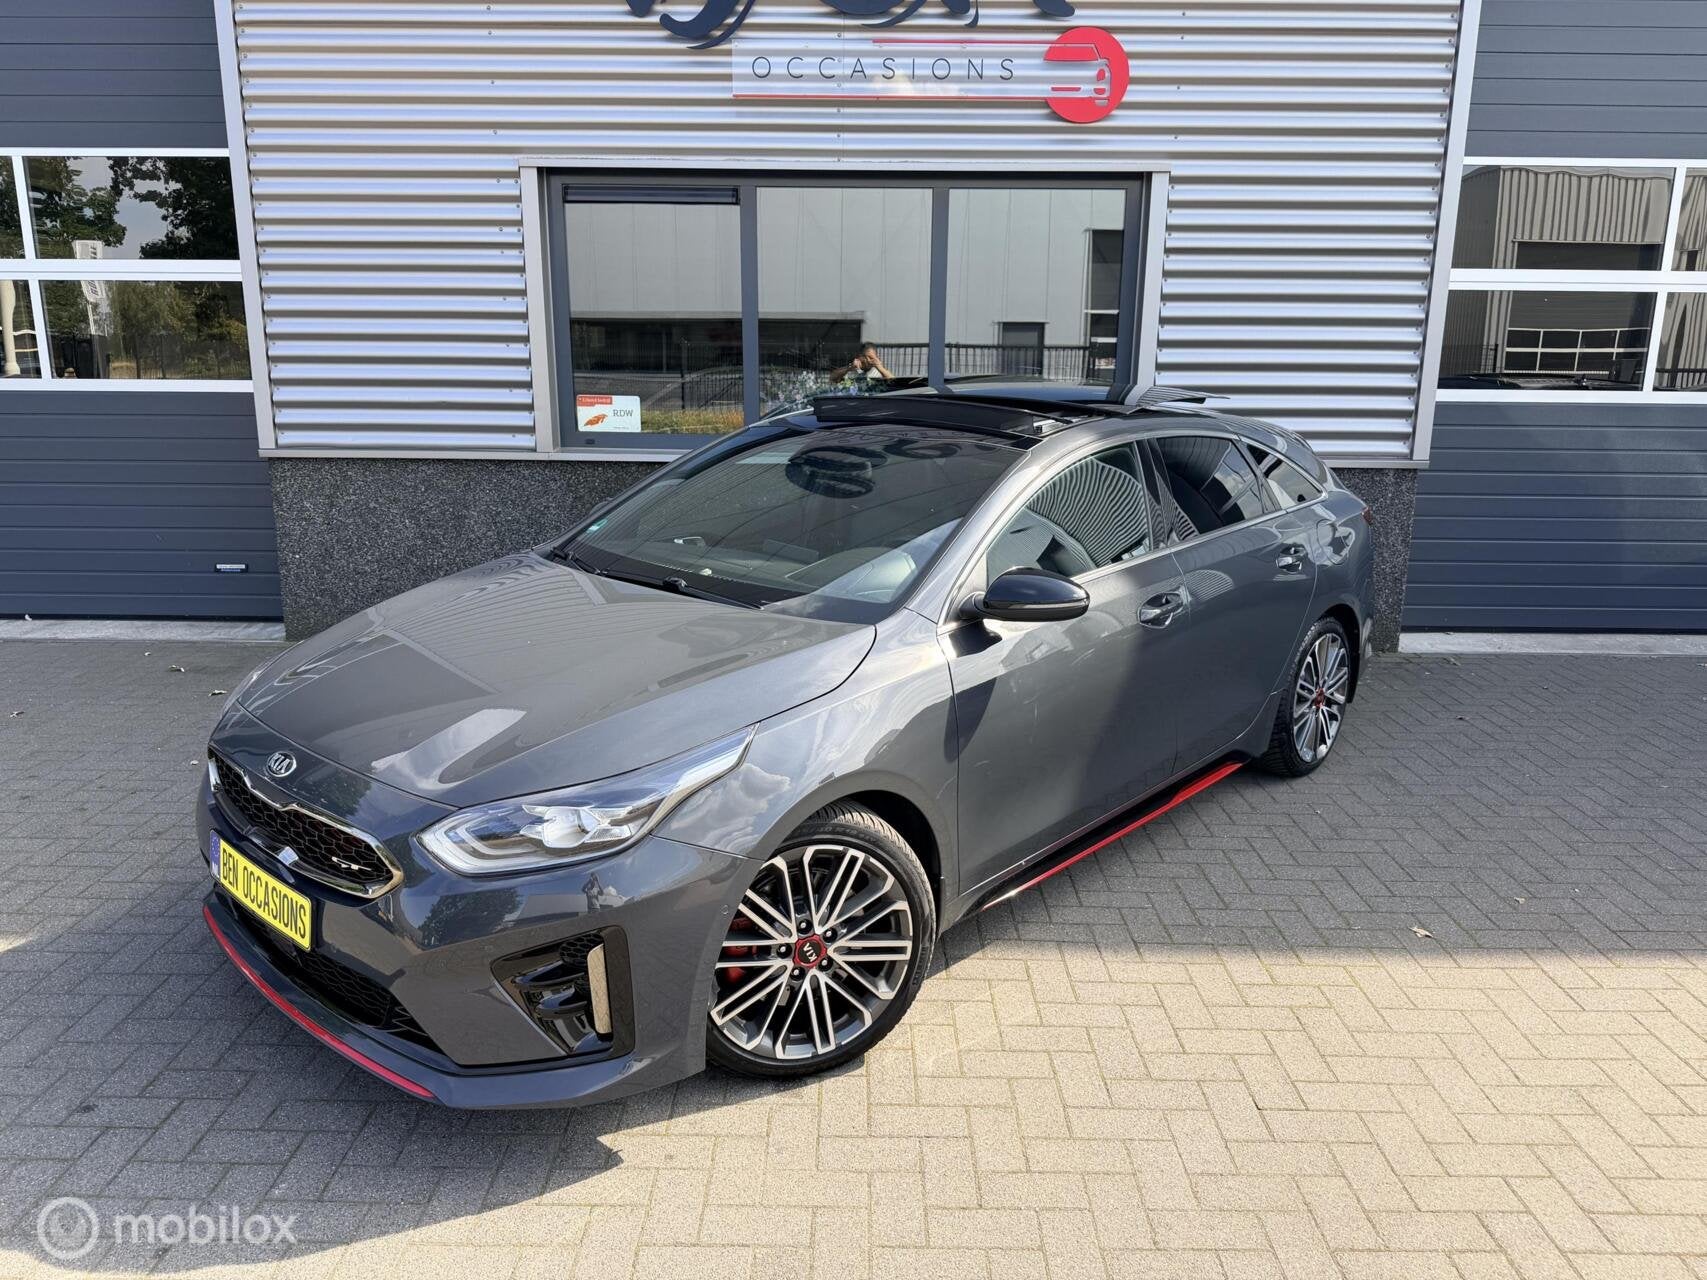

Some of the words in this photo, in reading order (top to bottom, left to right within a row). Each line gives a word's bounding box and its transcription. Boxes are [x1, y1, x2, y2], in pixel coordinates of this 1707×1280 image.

[751, 56, 1014, 80] OCCASIONS
[613, 409, 633, 417] RDW
[222, 847, 239, 891] BEN
[242, 866, 307, 939] OCCASIONS
